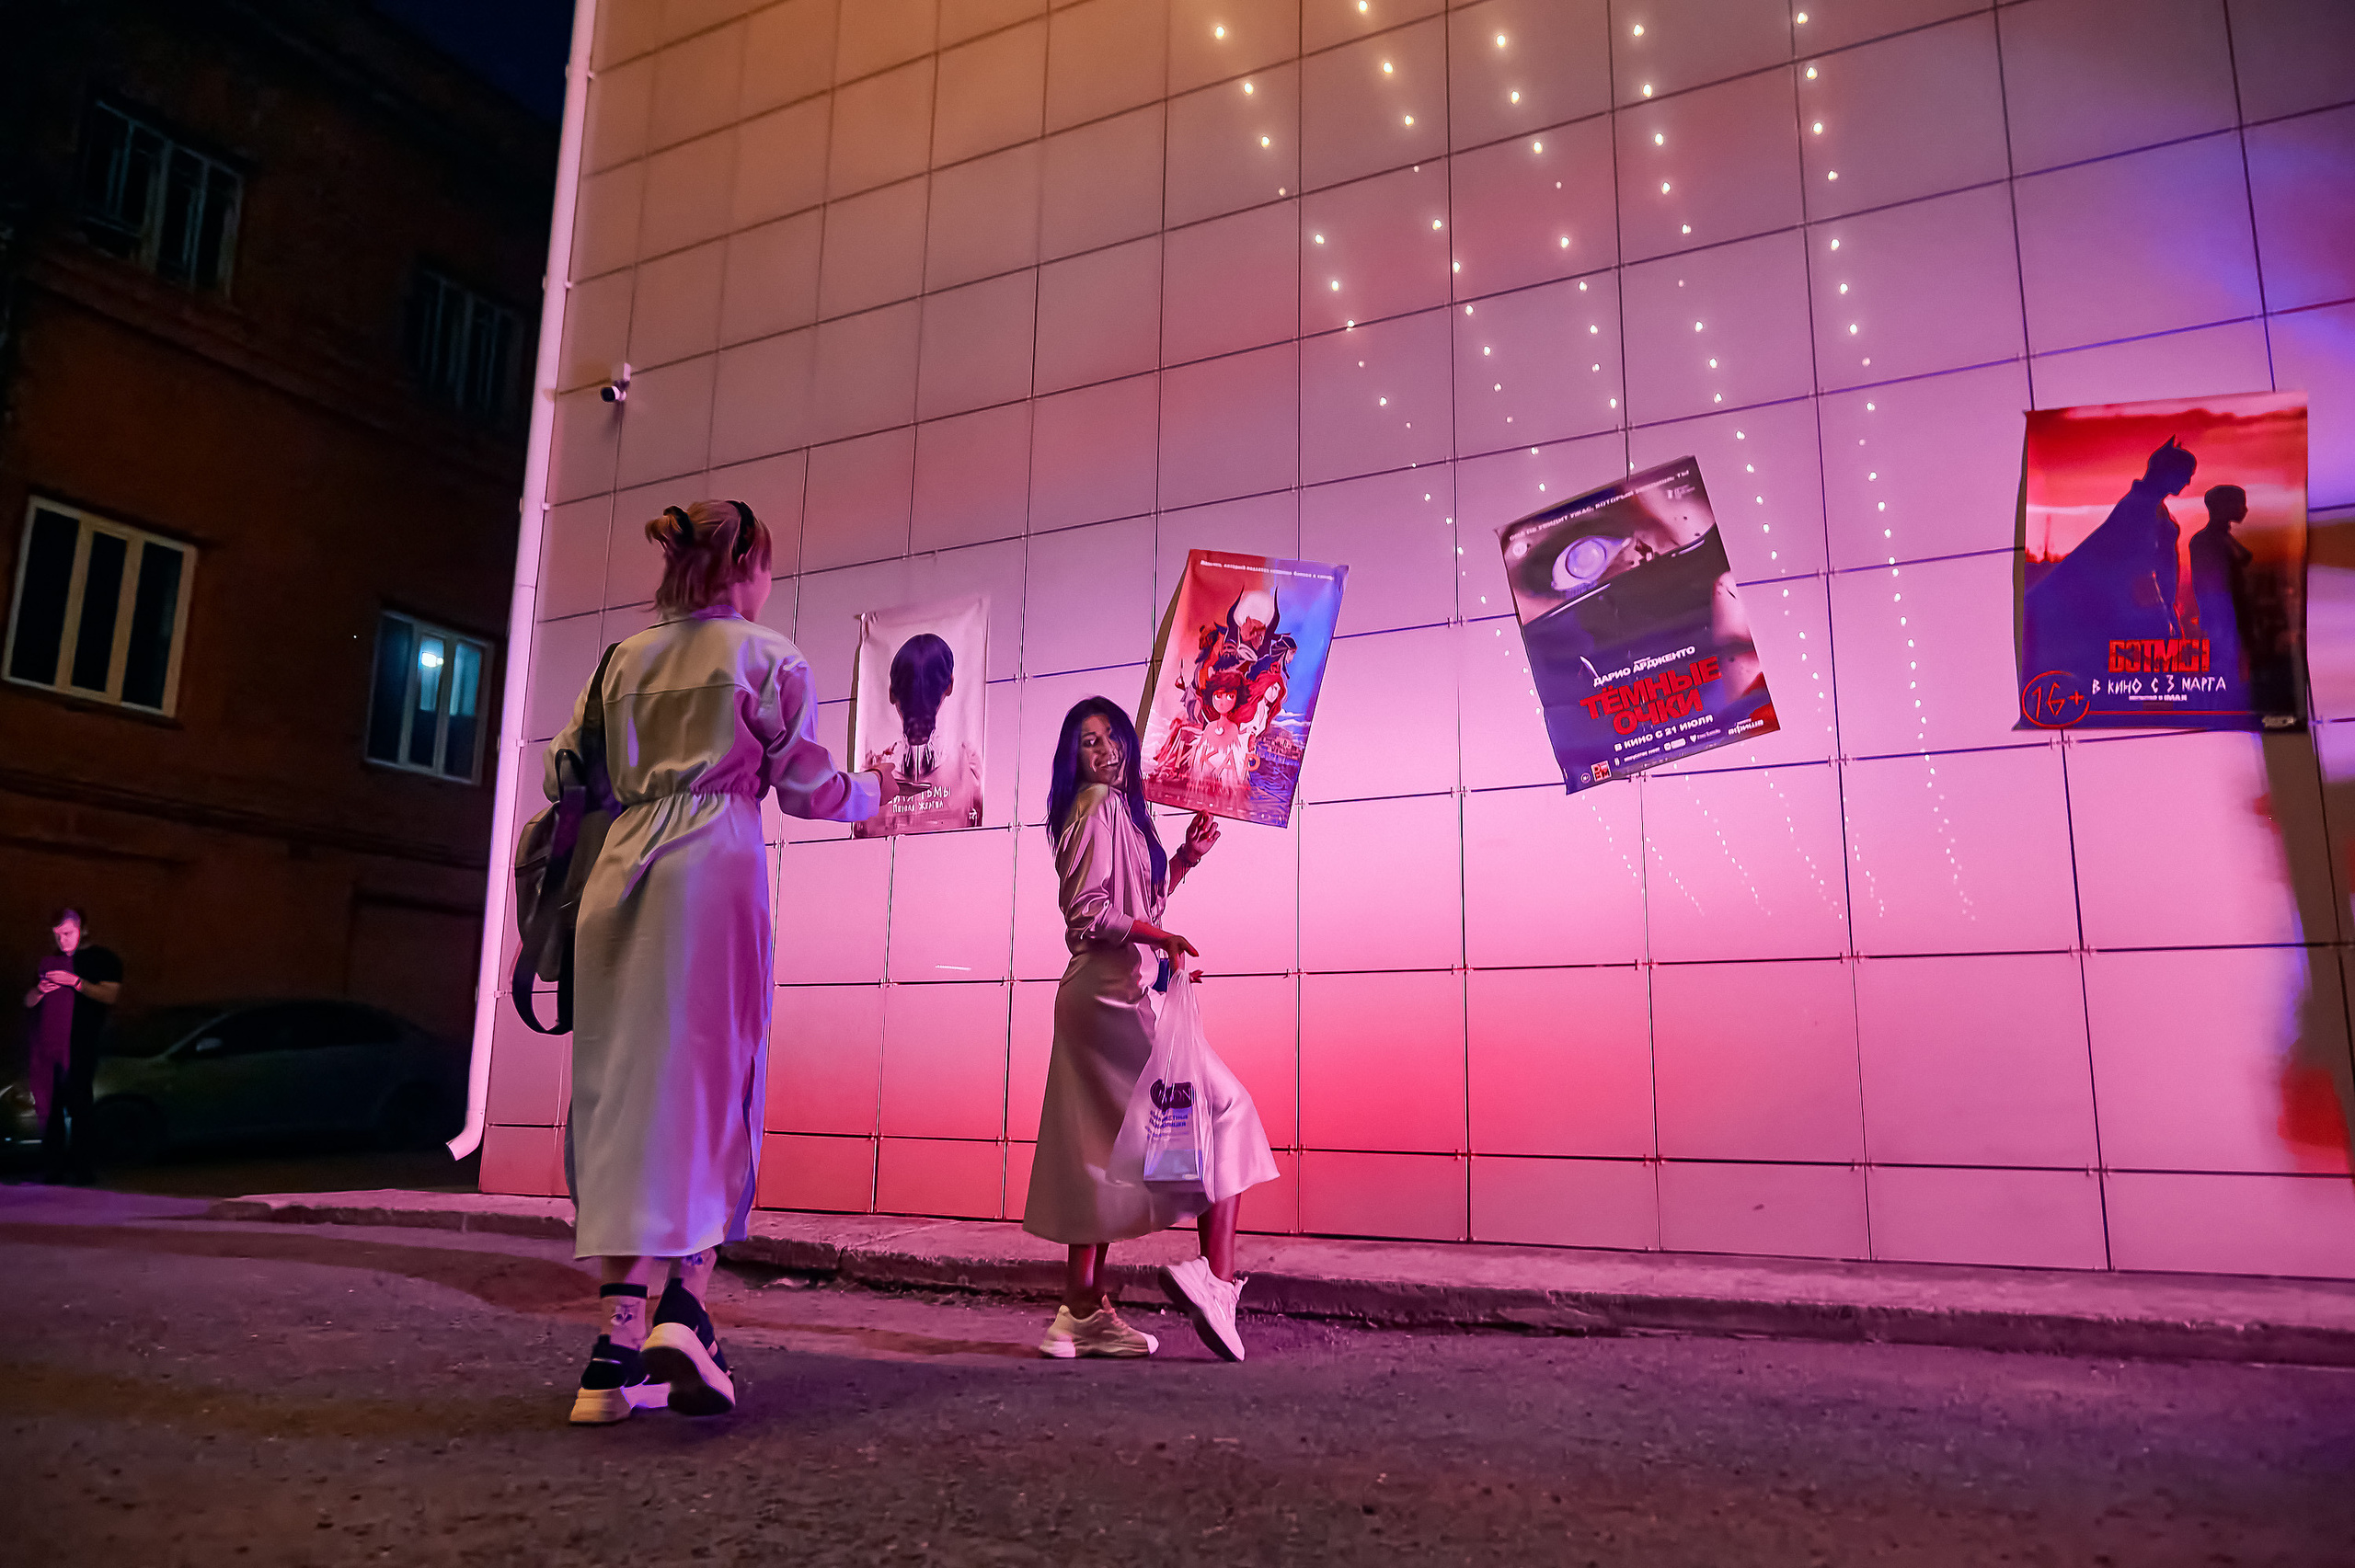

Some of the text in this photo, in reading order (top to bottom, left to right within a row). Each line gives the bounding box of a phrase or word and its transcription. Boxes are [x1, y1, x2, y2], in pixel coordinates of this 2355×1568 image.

[1593, 646, 1696, 688] ДАРИО АРДЖЕНТО
[2092, 674, 2227, 695] В КИНО С 3 МАРТА
[1580, 656, 1722, 719] ТЁМНЫЕ
[2031, 681, 2085, 720] 16+
[1613, 688, 1704, 735] ОЧКИ
[1614, 742, 1623, 752] В
[1624, 733, 1653, 750] КИНО
[1655, 729, 1663, 738] С
[1664, 725, 1678, 737] 21
[1679, 714, 1714, 732] ИЮЛЯ
